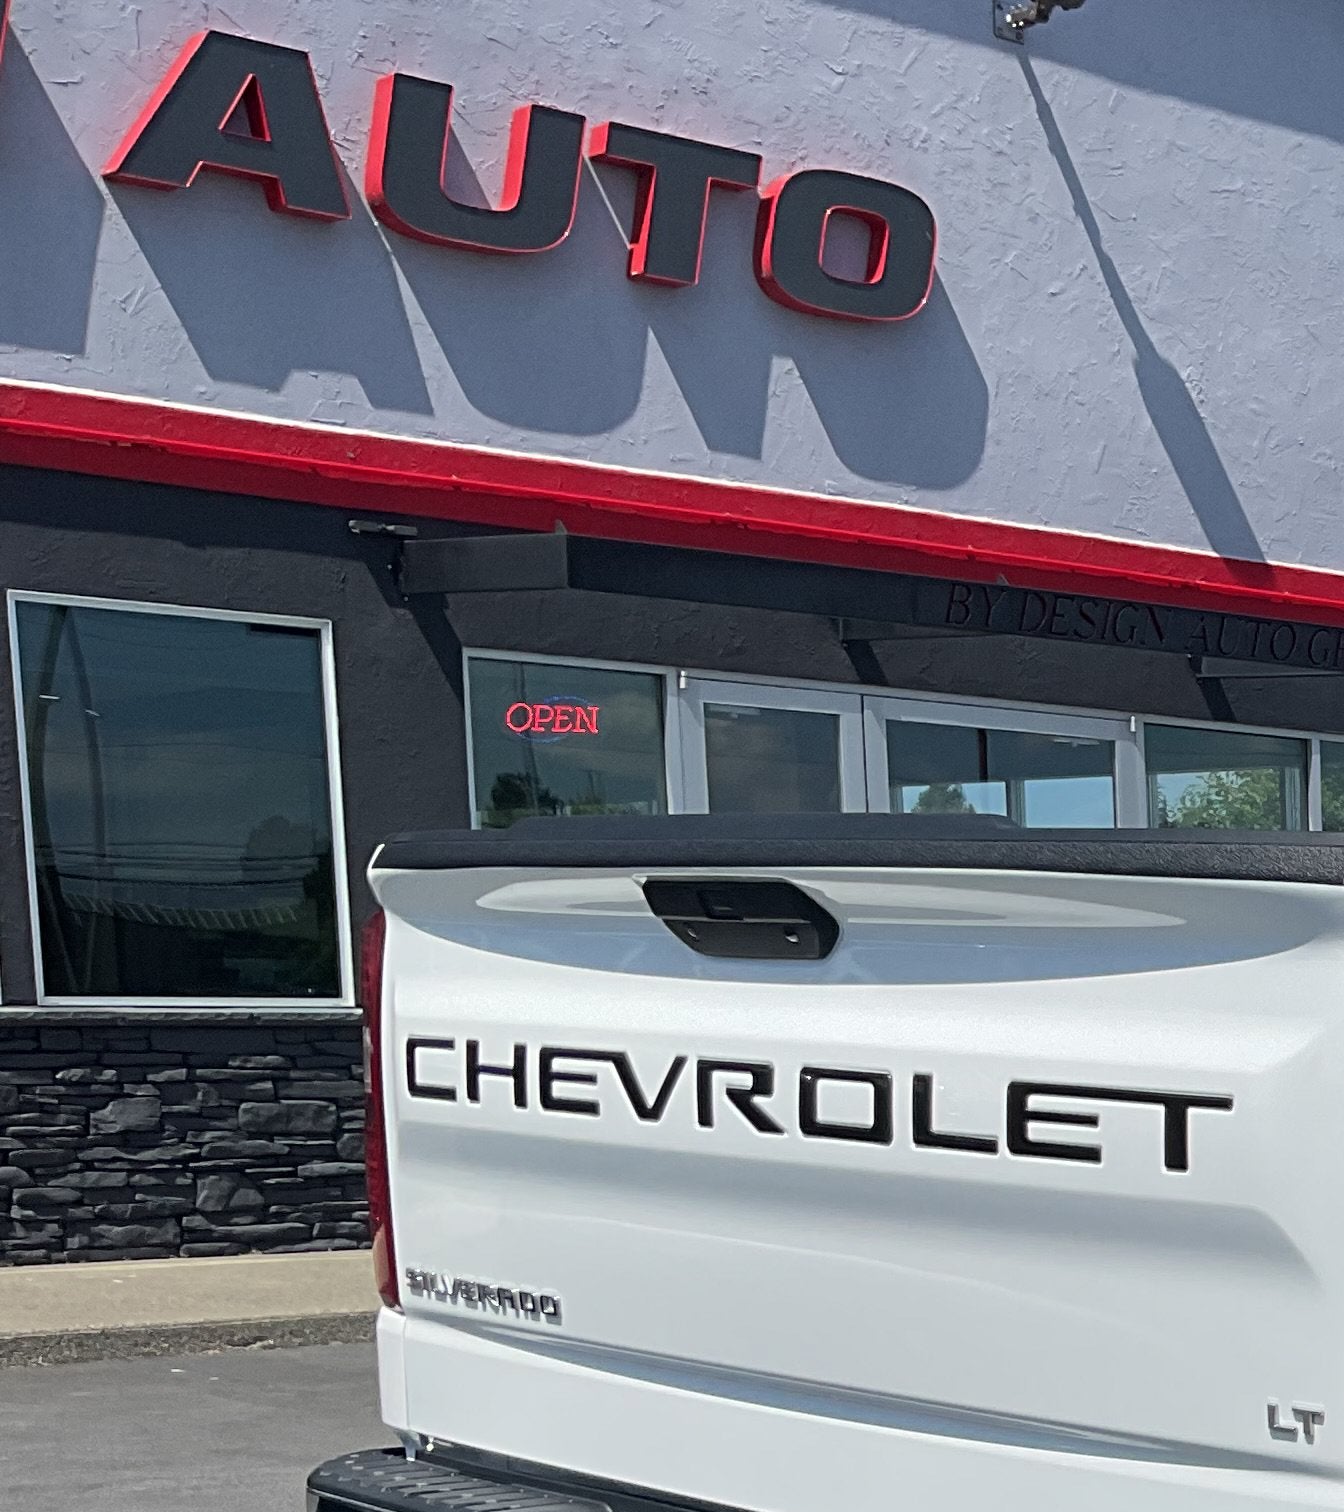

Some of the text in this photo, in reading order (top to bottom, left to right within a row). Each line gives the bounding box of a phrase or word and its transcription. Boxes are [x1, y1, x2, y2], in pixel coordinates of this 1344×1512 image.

[103, 28, 937, 322] AUTO
[944, 582, 1007, 627] BY
[1017, 593, 1171, 645] DESIGN
[1185, 612, 1298, 662] AUTO
[505, 702, 600, 735] OPEN
[405, 1036, 1234, 1172] CHEVROLET
[405, 1267, 559, 1320] SILVERADO
[1266, 1402, 1325, 1442] LT
